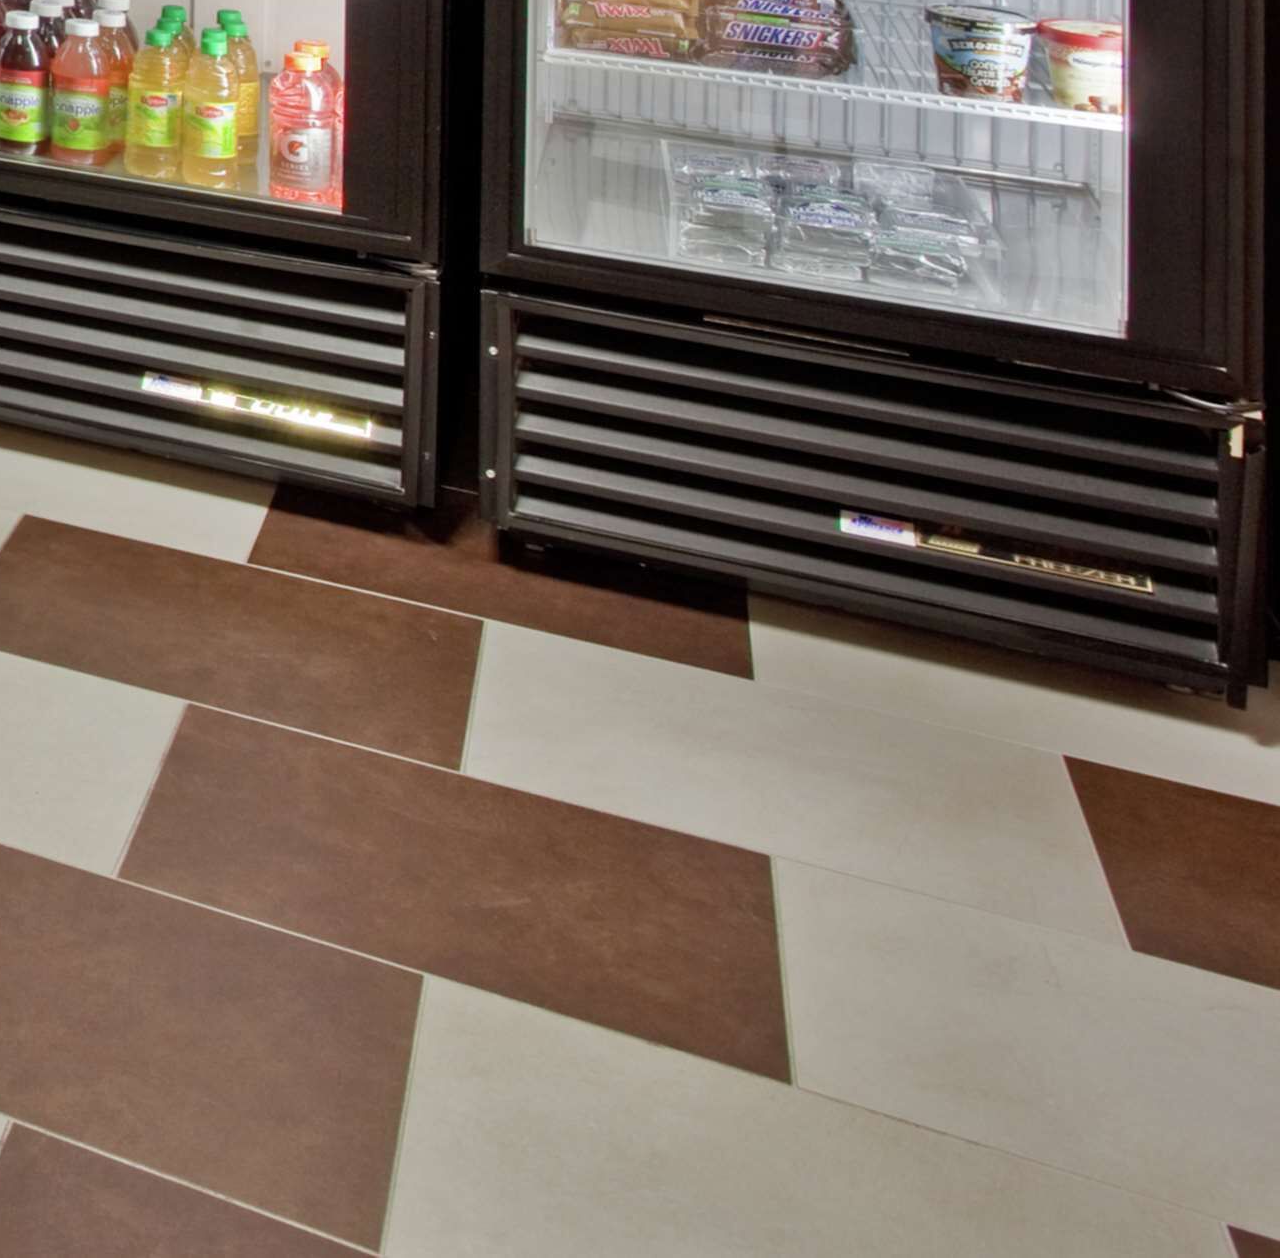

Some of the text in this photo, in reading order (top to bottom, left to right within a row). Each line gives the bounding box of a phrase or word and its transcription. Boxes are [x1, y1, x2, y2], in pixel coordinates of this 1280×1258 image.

[592, 2, 652, 20] TWIX
[723, 21, 819, 49] SNICKERS
[281, 135, 309, 163] G
